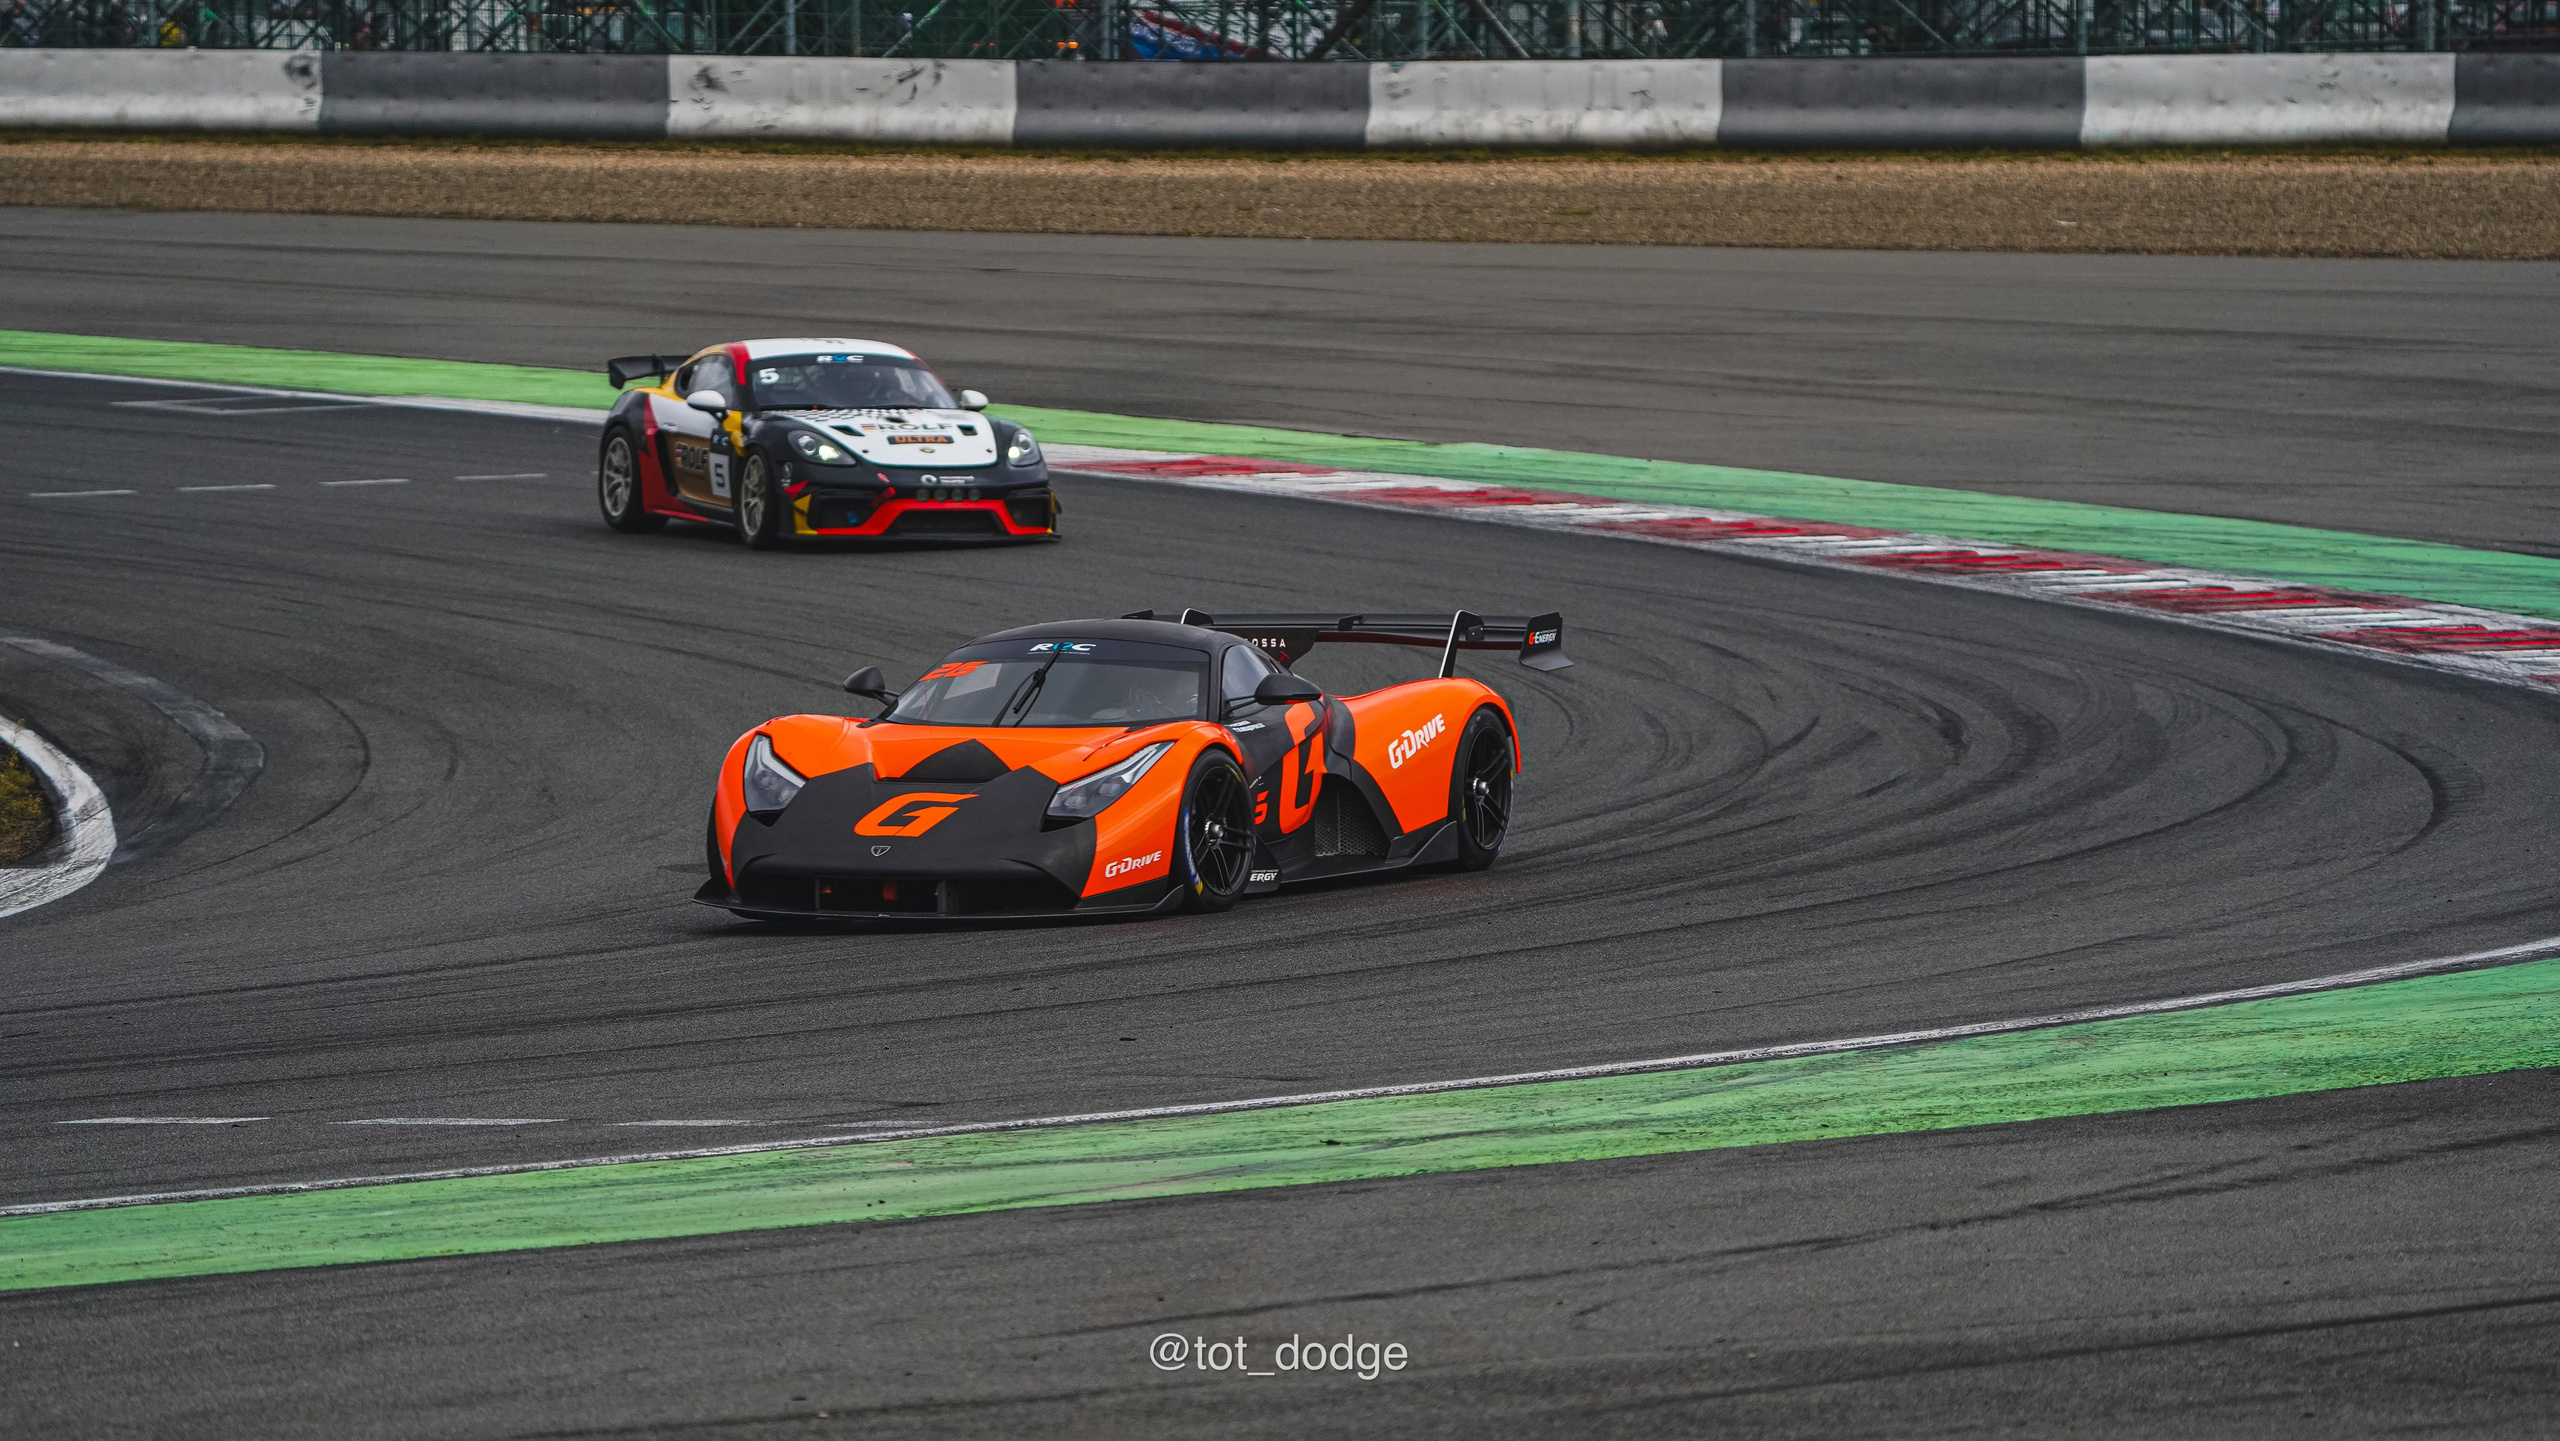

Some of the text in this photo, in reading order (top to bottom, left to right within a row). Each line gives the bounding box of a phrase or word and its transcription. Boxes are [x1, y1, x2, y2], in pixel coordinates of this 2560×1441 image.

[759, 367, 780, 385] 5
[894, 435, 949, 444] ULTRA
[714, 462, 727, 489] 5
[1244, 638, 1286, 648] OSSA
[918, 660, 989, 682] 26
[853, 791, 980, 838] G
